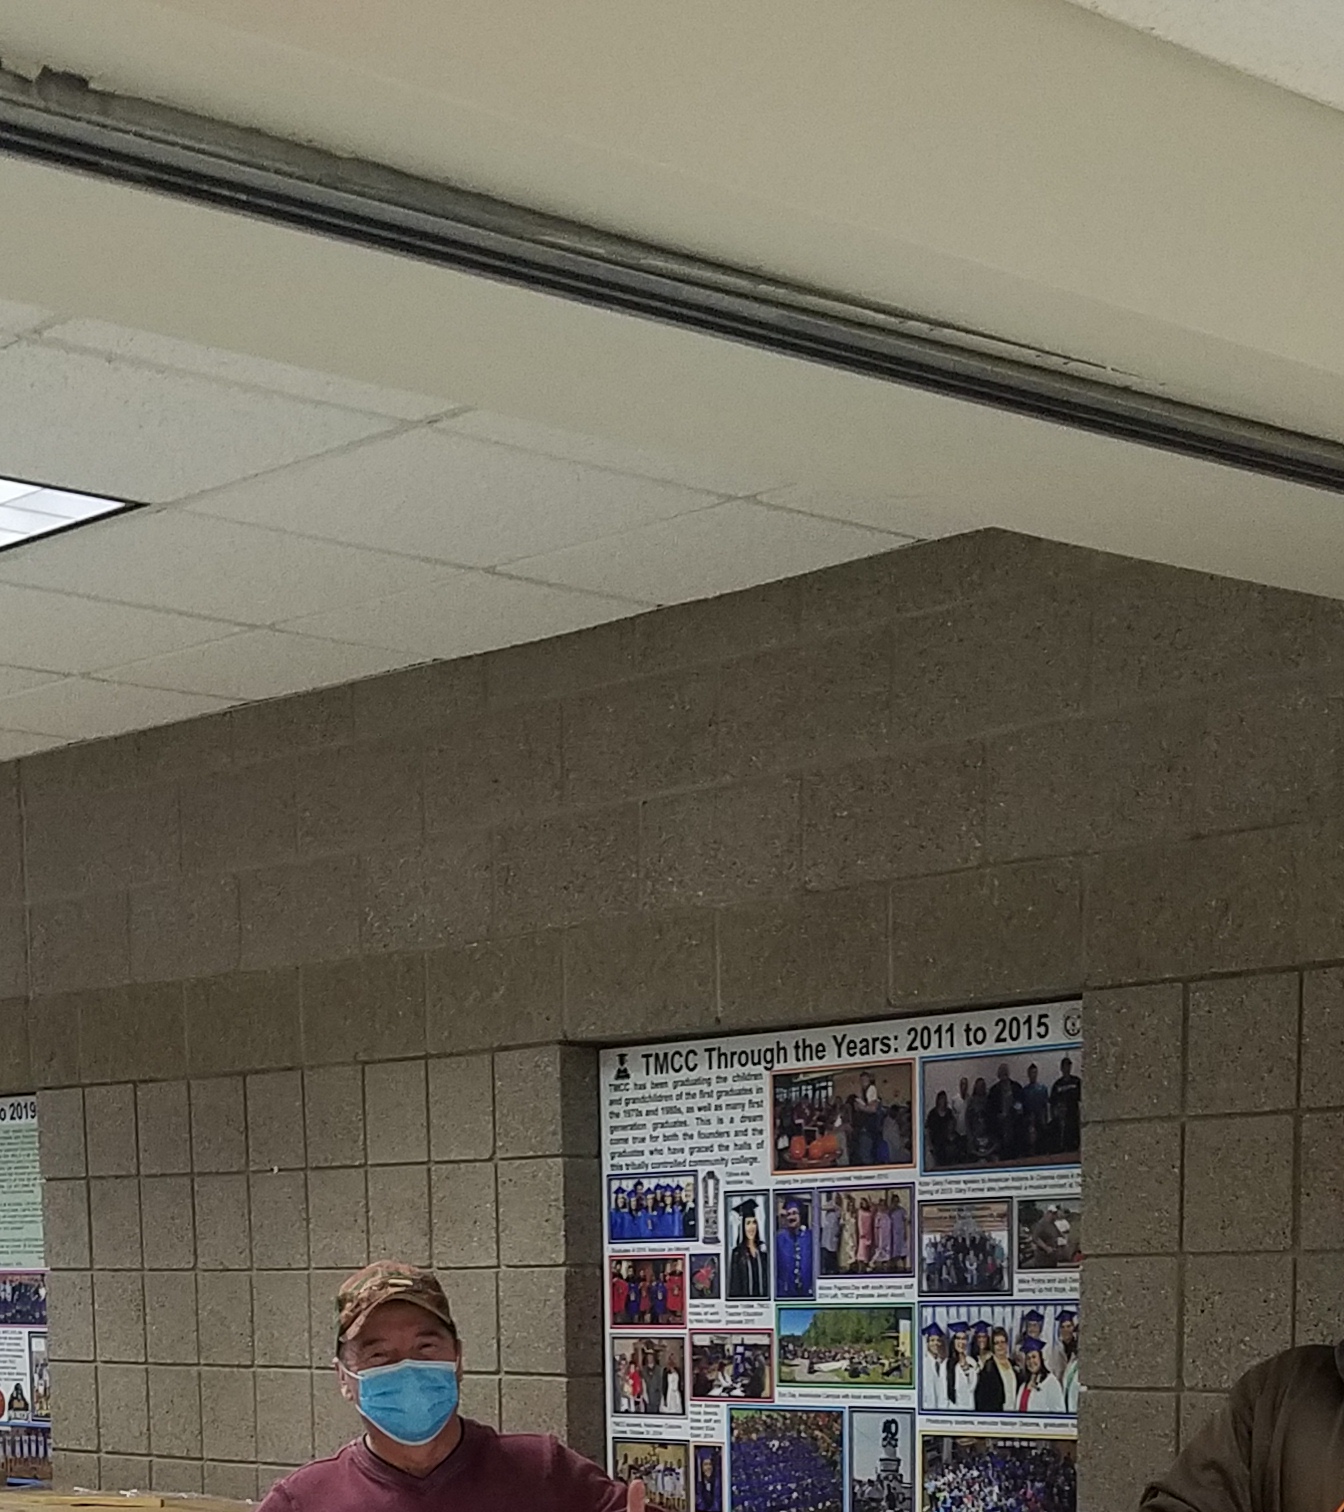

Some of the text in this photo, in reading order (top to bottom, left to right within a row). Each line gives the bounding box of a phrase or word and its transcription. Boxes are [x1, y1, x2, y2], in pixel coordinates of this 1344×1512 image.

[642, 1013, 1049, 1077] TMCC Through the Years: 2011 to 2015
[9, 1101, 36, 1120] 2019
